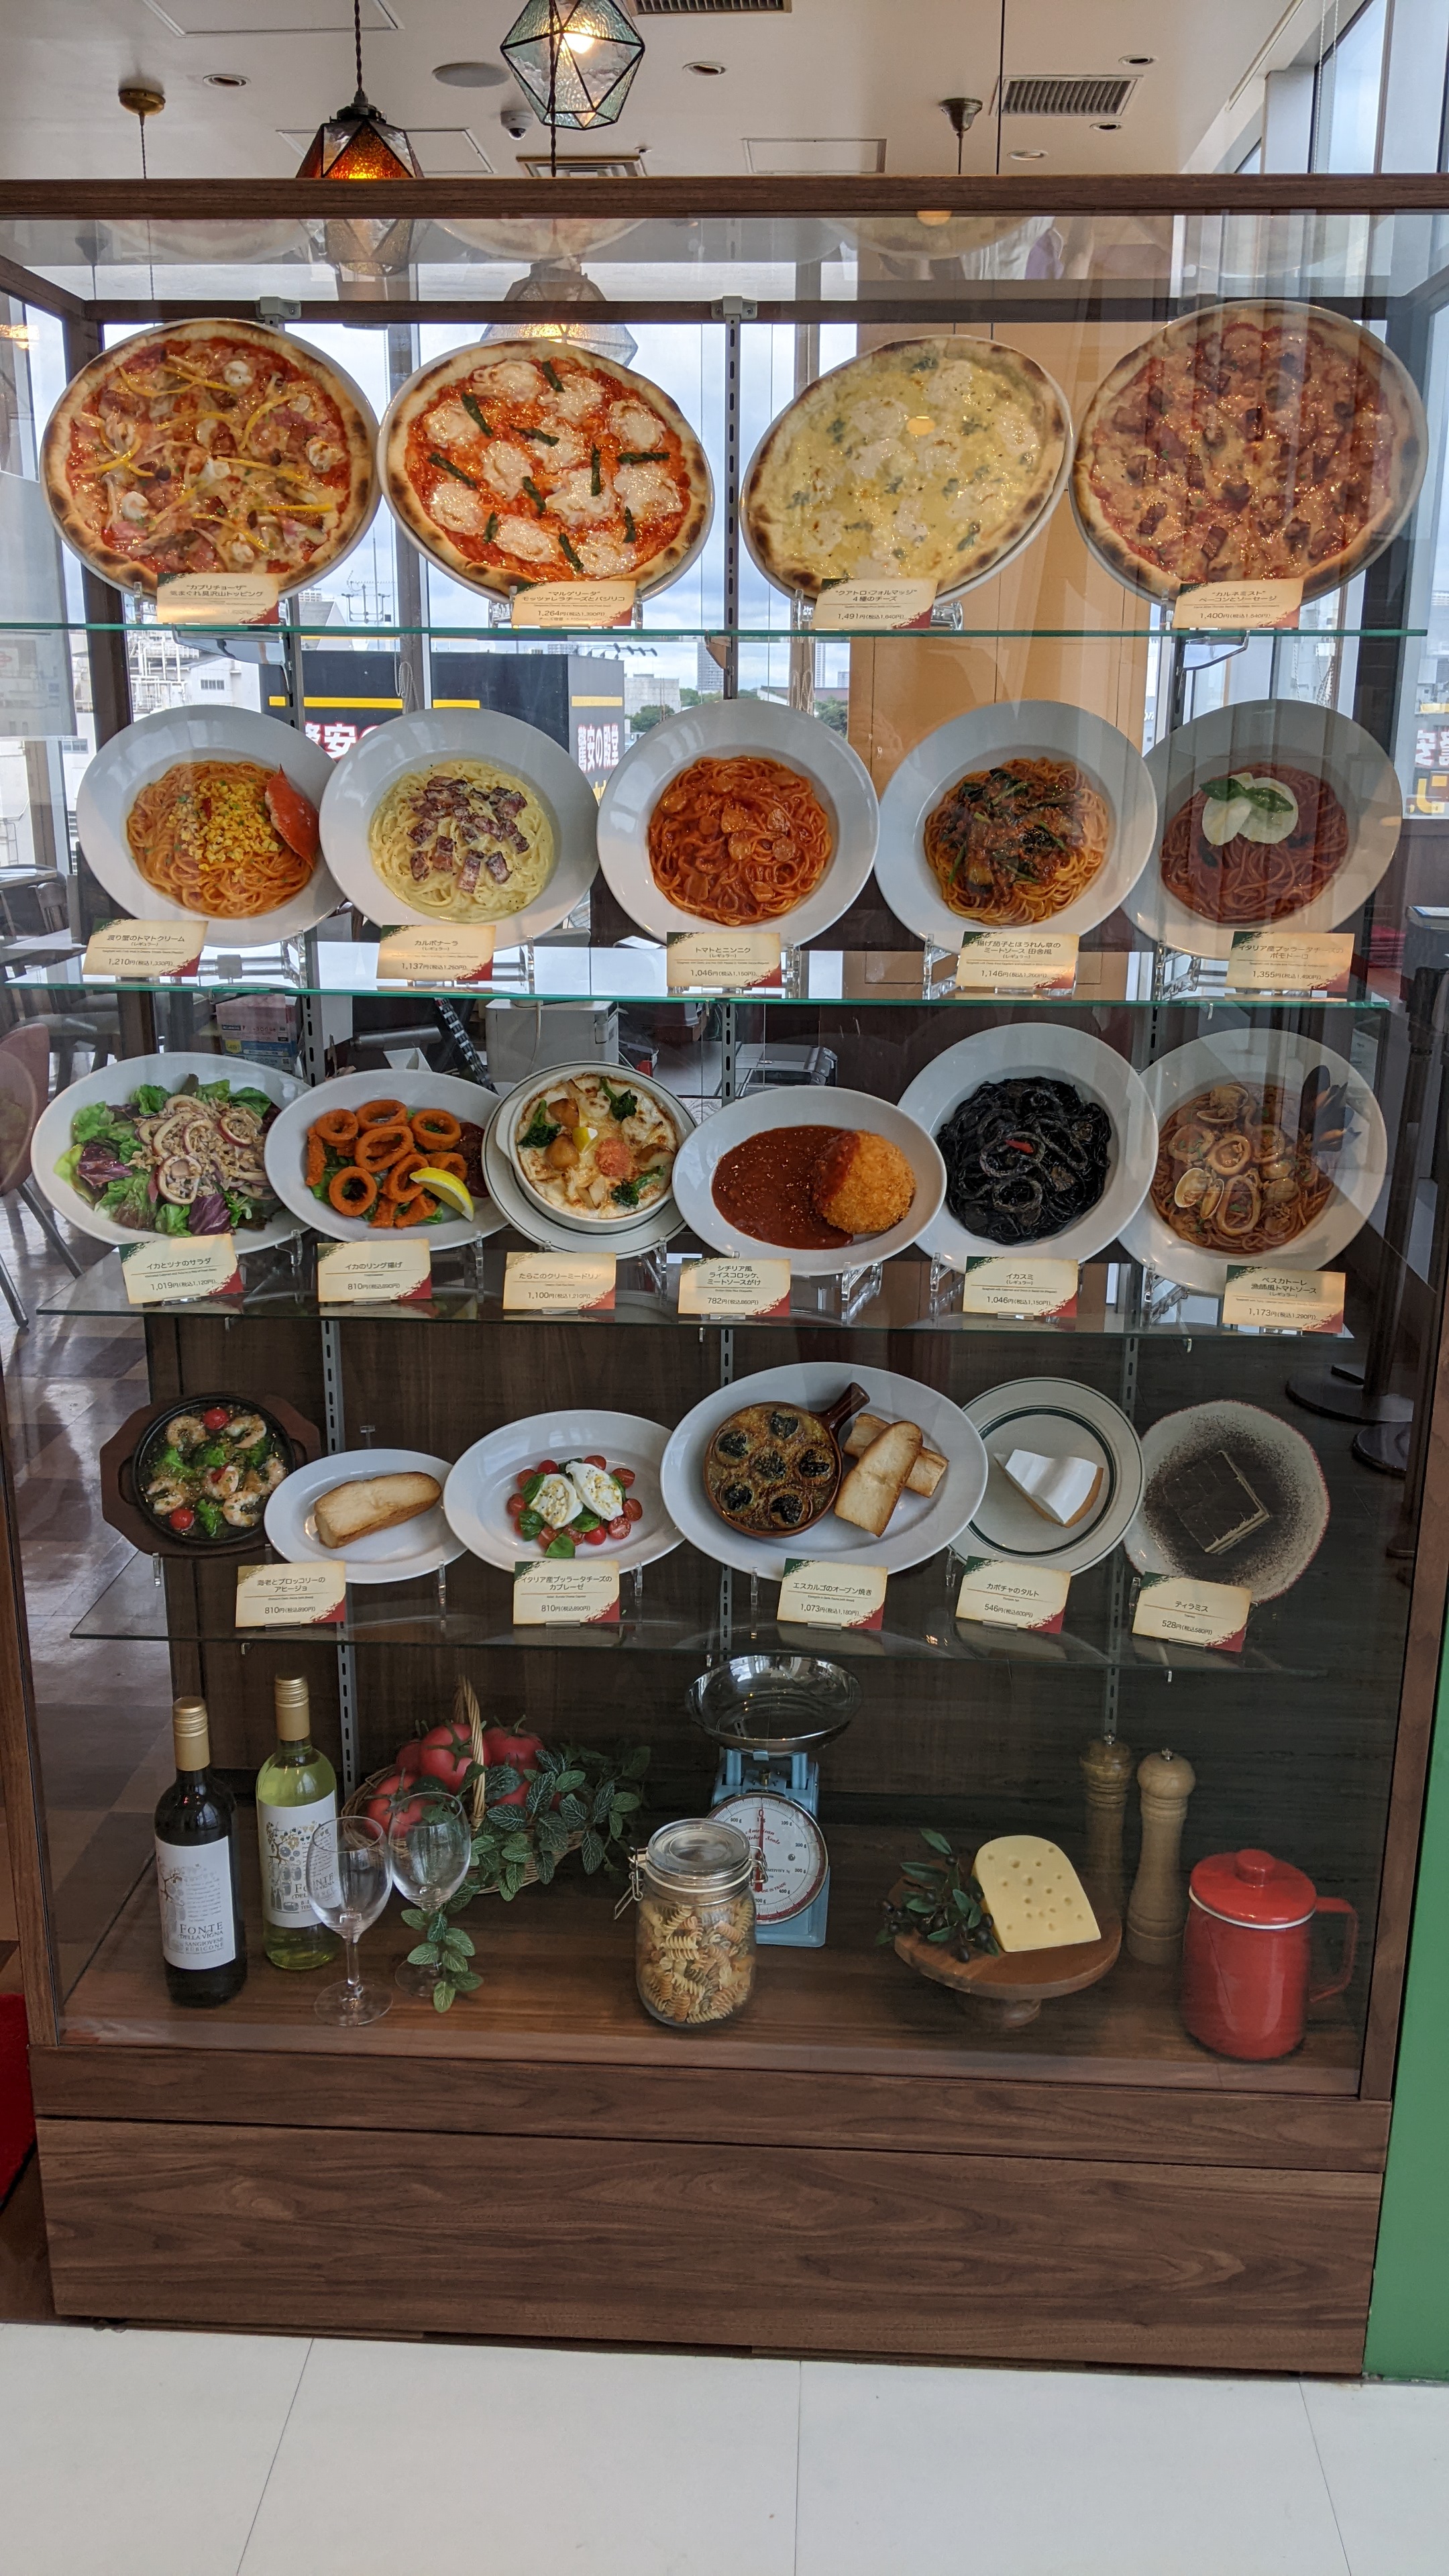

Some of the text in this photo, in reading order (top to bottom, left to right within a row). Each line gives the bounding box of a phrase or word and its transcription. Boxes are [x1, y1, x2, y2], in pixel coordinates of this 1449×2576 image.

[977, 941, 1061, 949] 揚げ茄子とほうれん草の
[146, 1257, 211, 1270] イカとツナのサラダ
[345, 1262, 402, 1270] イカのリング揚げ
[257, 1576, 325, 1587] 海老とブロッコリーの
[793, 1582, 872, 1596] エスカルゴのオーブン焼き
[1175, 1601, 1208, 1612] ティラミス
[185, 1937, 223, 1947] SANGIOVESE
